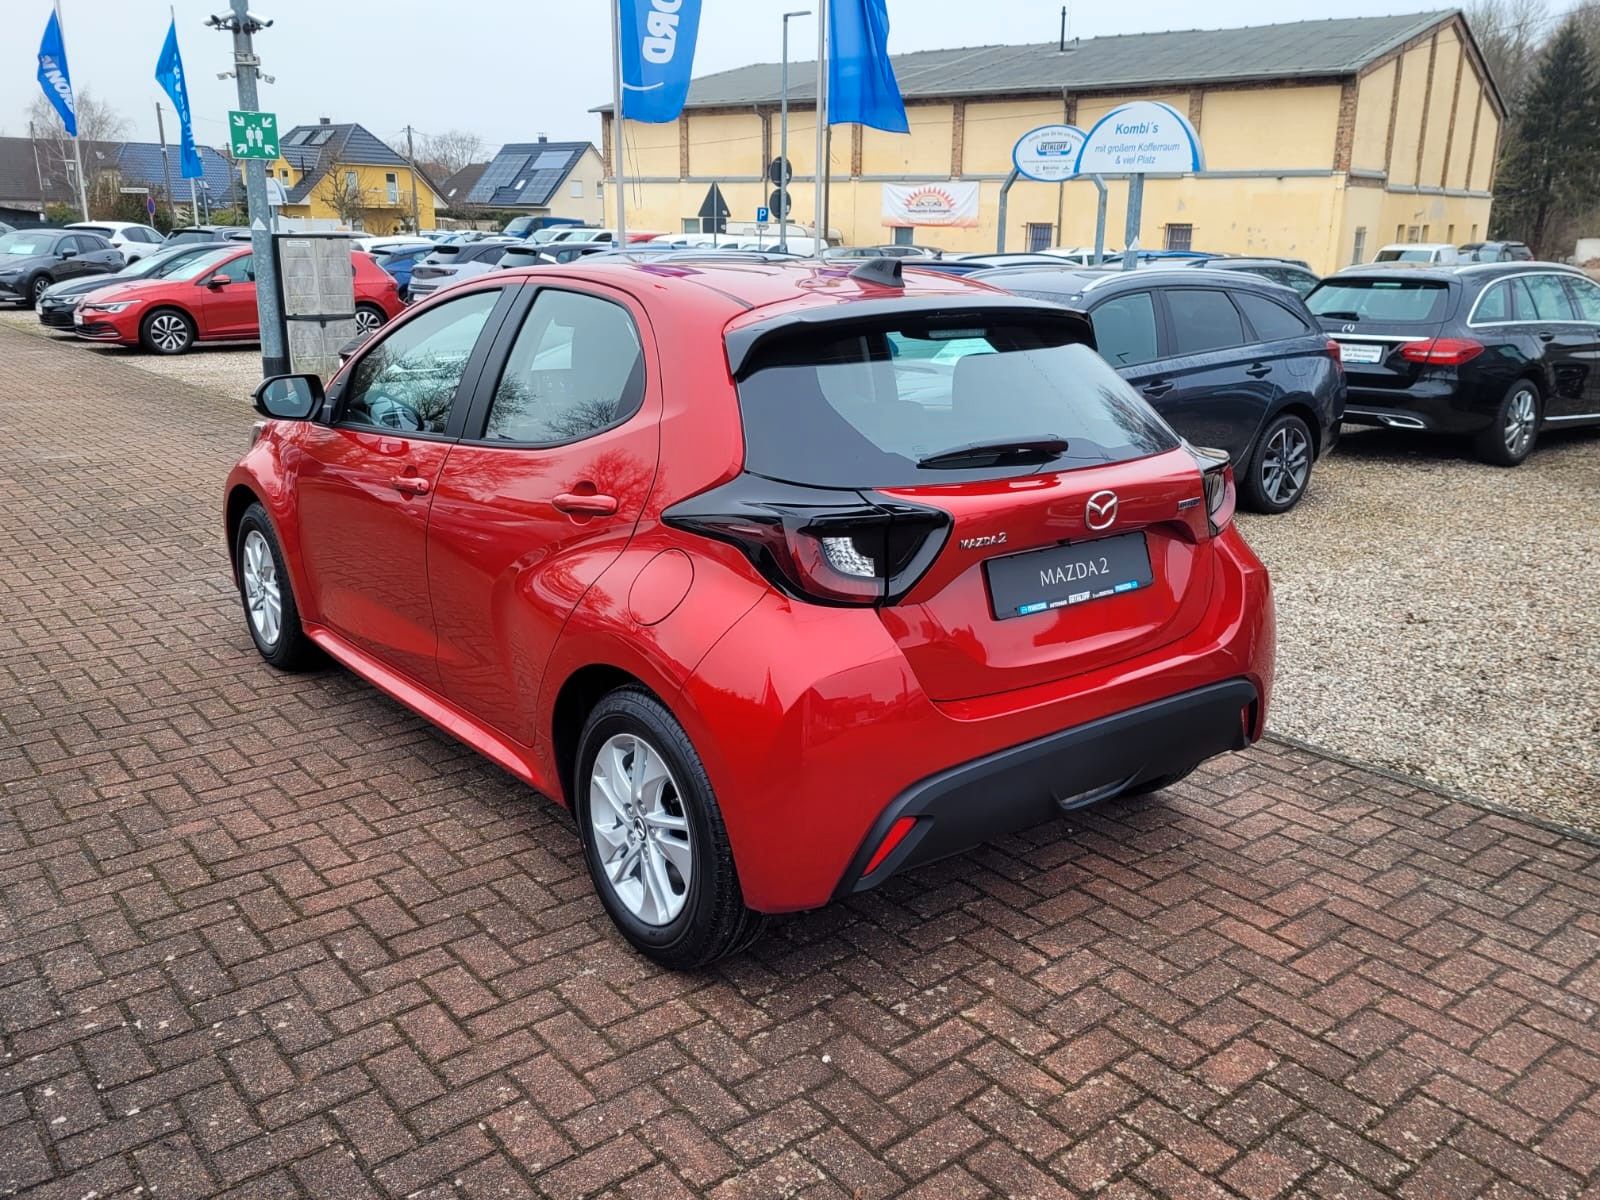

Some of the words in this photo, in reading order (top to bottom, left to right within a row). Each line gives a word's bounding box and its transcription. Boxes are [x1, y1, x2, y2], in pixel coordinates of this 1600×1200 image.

[1094, 144, 1106, 153] mit
[1107, 143, 1136, 155] großem
[1137, 143, 1180, 152] Kofferraum
[1115, 156, 1121, 164] &
[1123, 155, 1136, 164] viel
[1136, 155, 1156, 164] Platz
[759, 208, 767, 220] P
